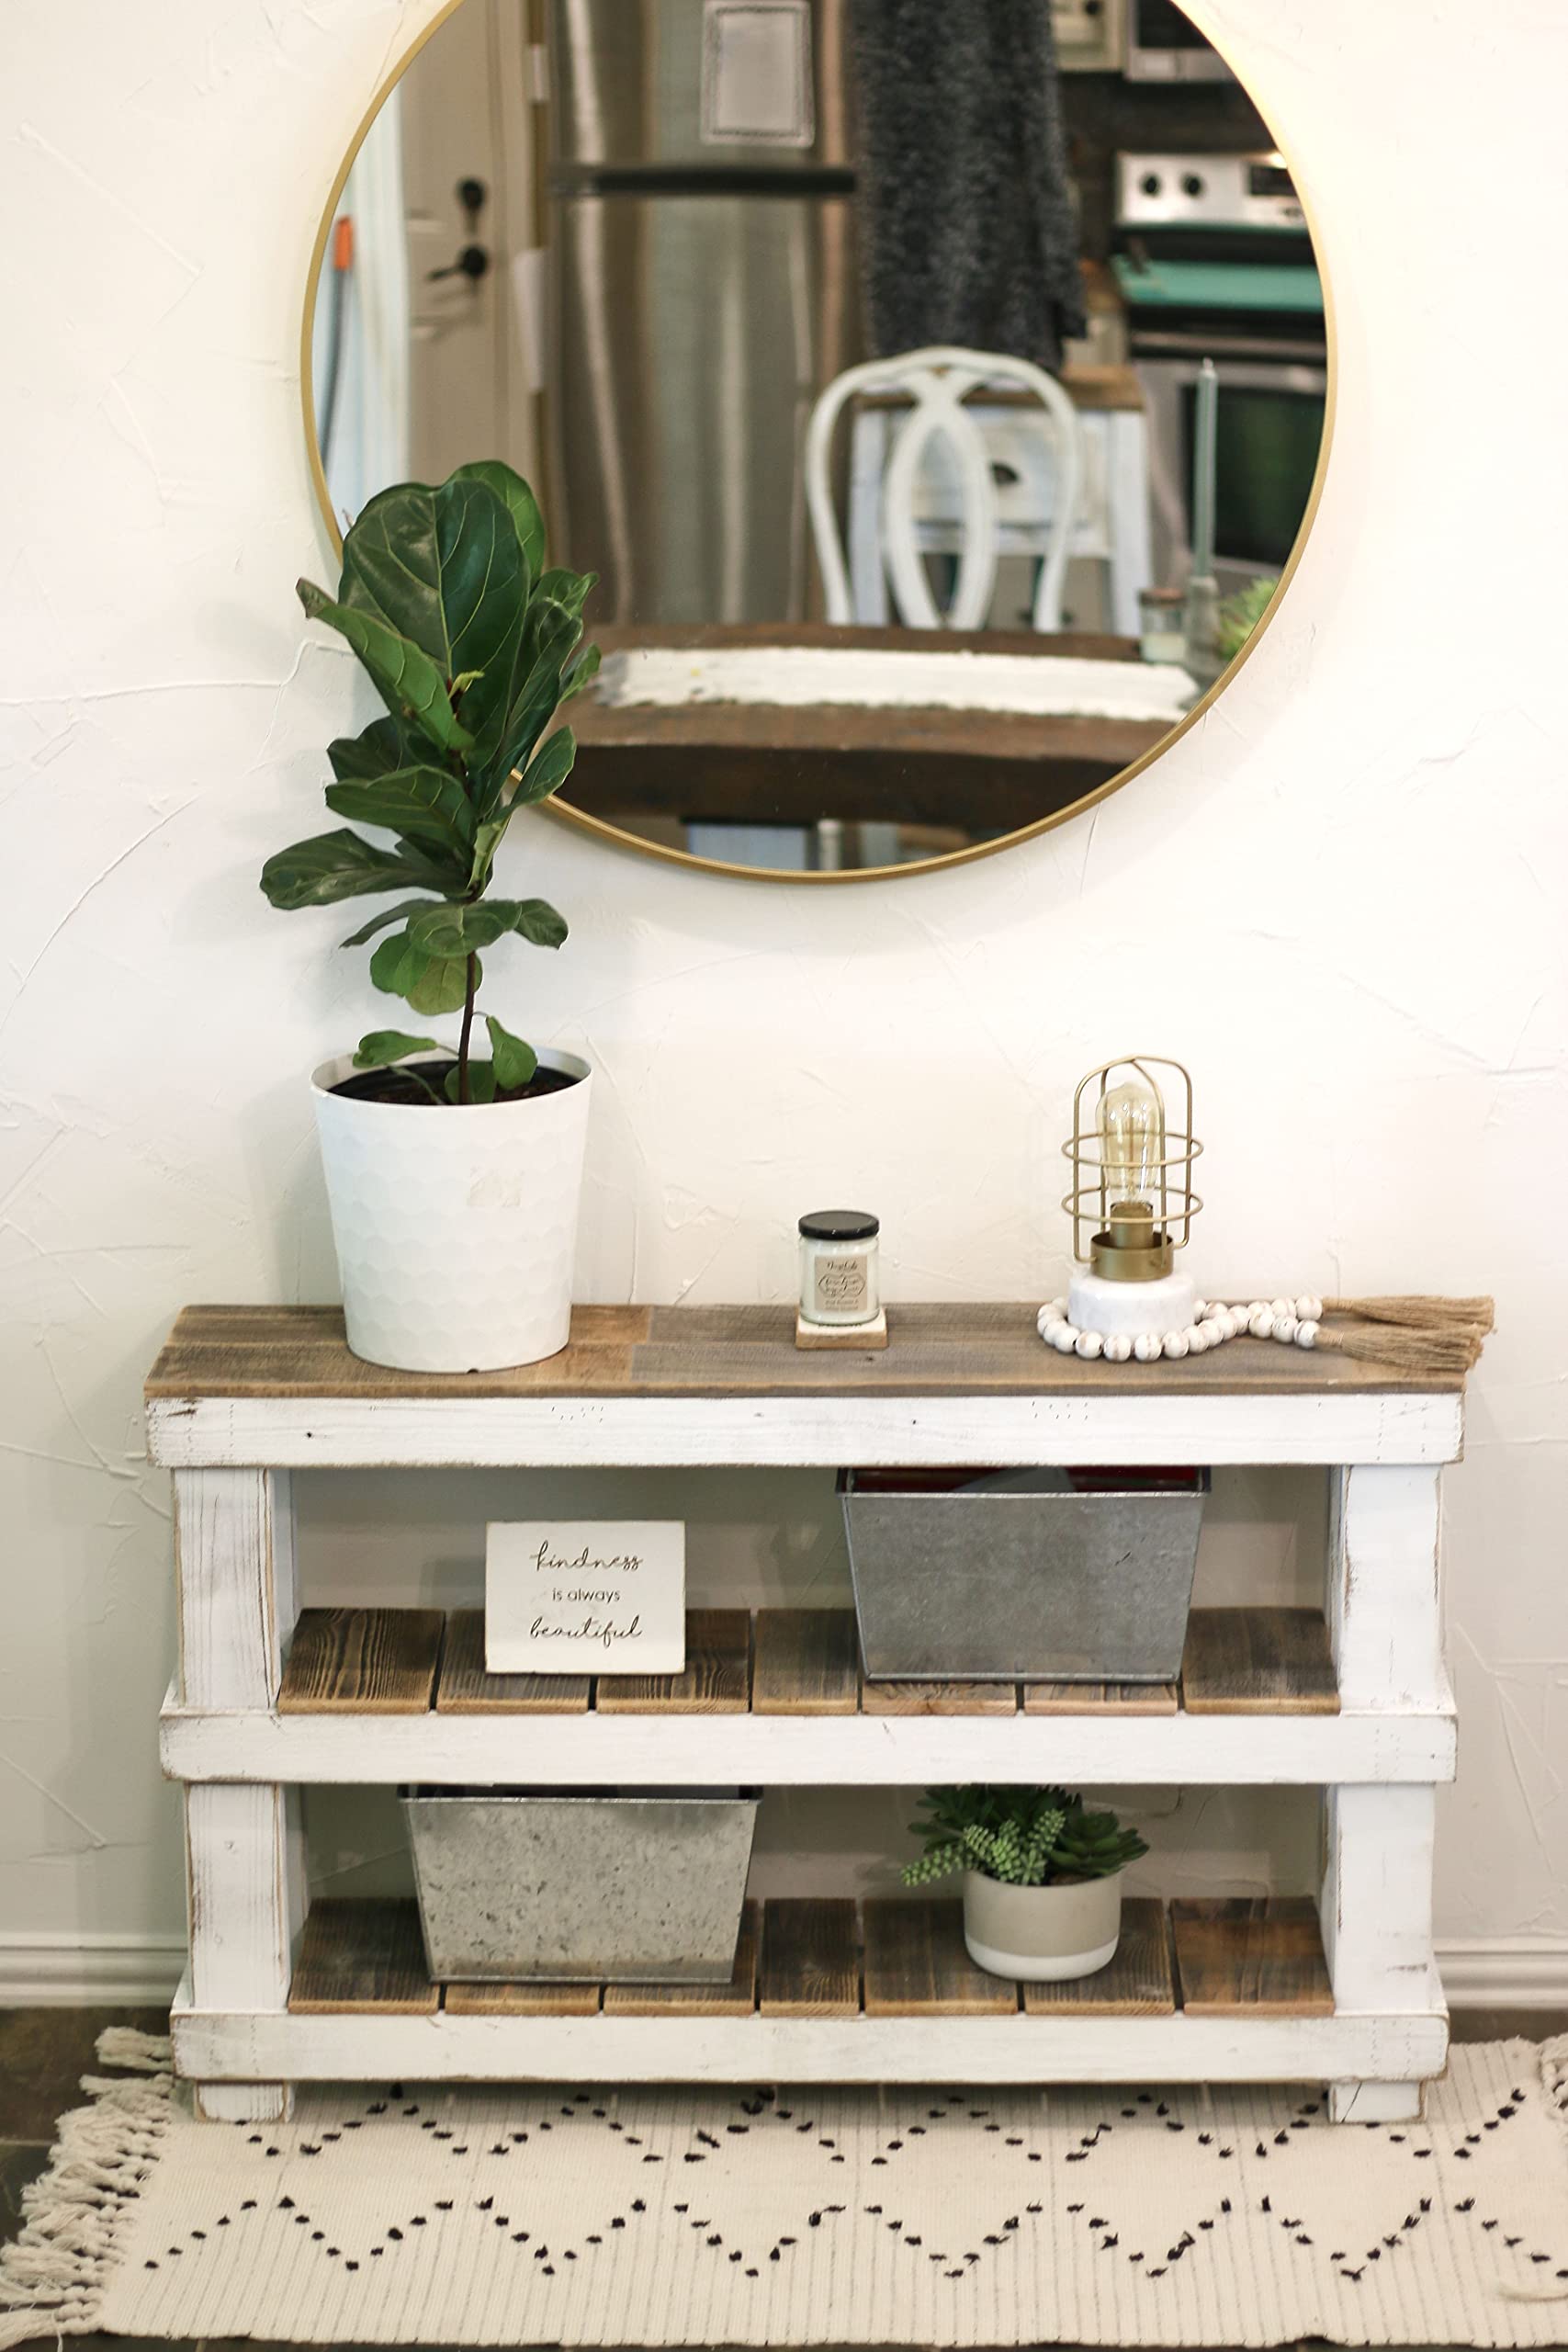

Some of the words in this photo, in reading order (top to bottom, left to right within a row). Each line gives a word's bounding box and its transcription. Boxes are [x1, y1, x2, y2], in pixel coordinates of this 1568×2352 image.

[529, 1539, 644, 1571] kindness
[552, 1588, 562, 1601] is
[568, 1588, 620, 1604] always
[529, 1614, 643, 1648] beautiful
